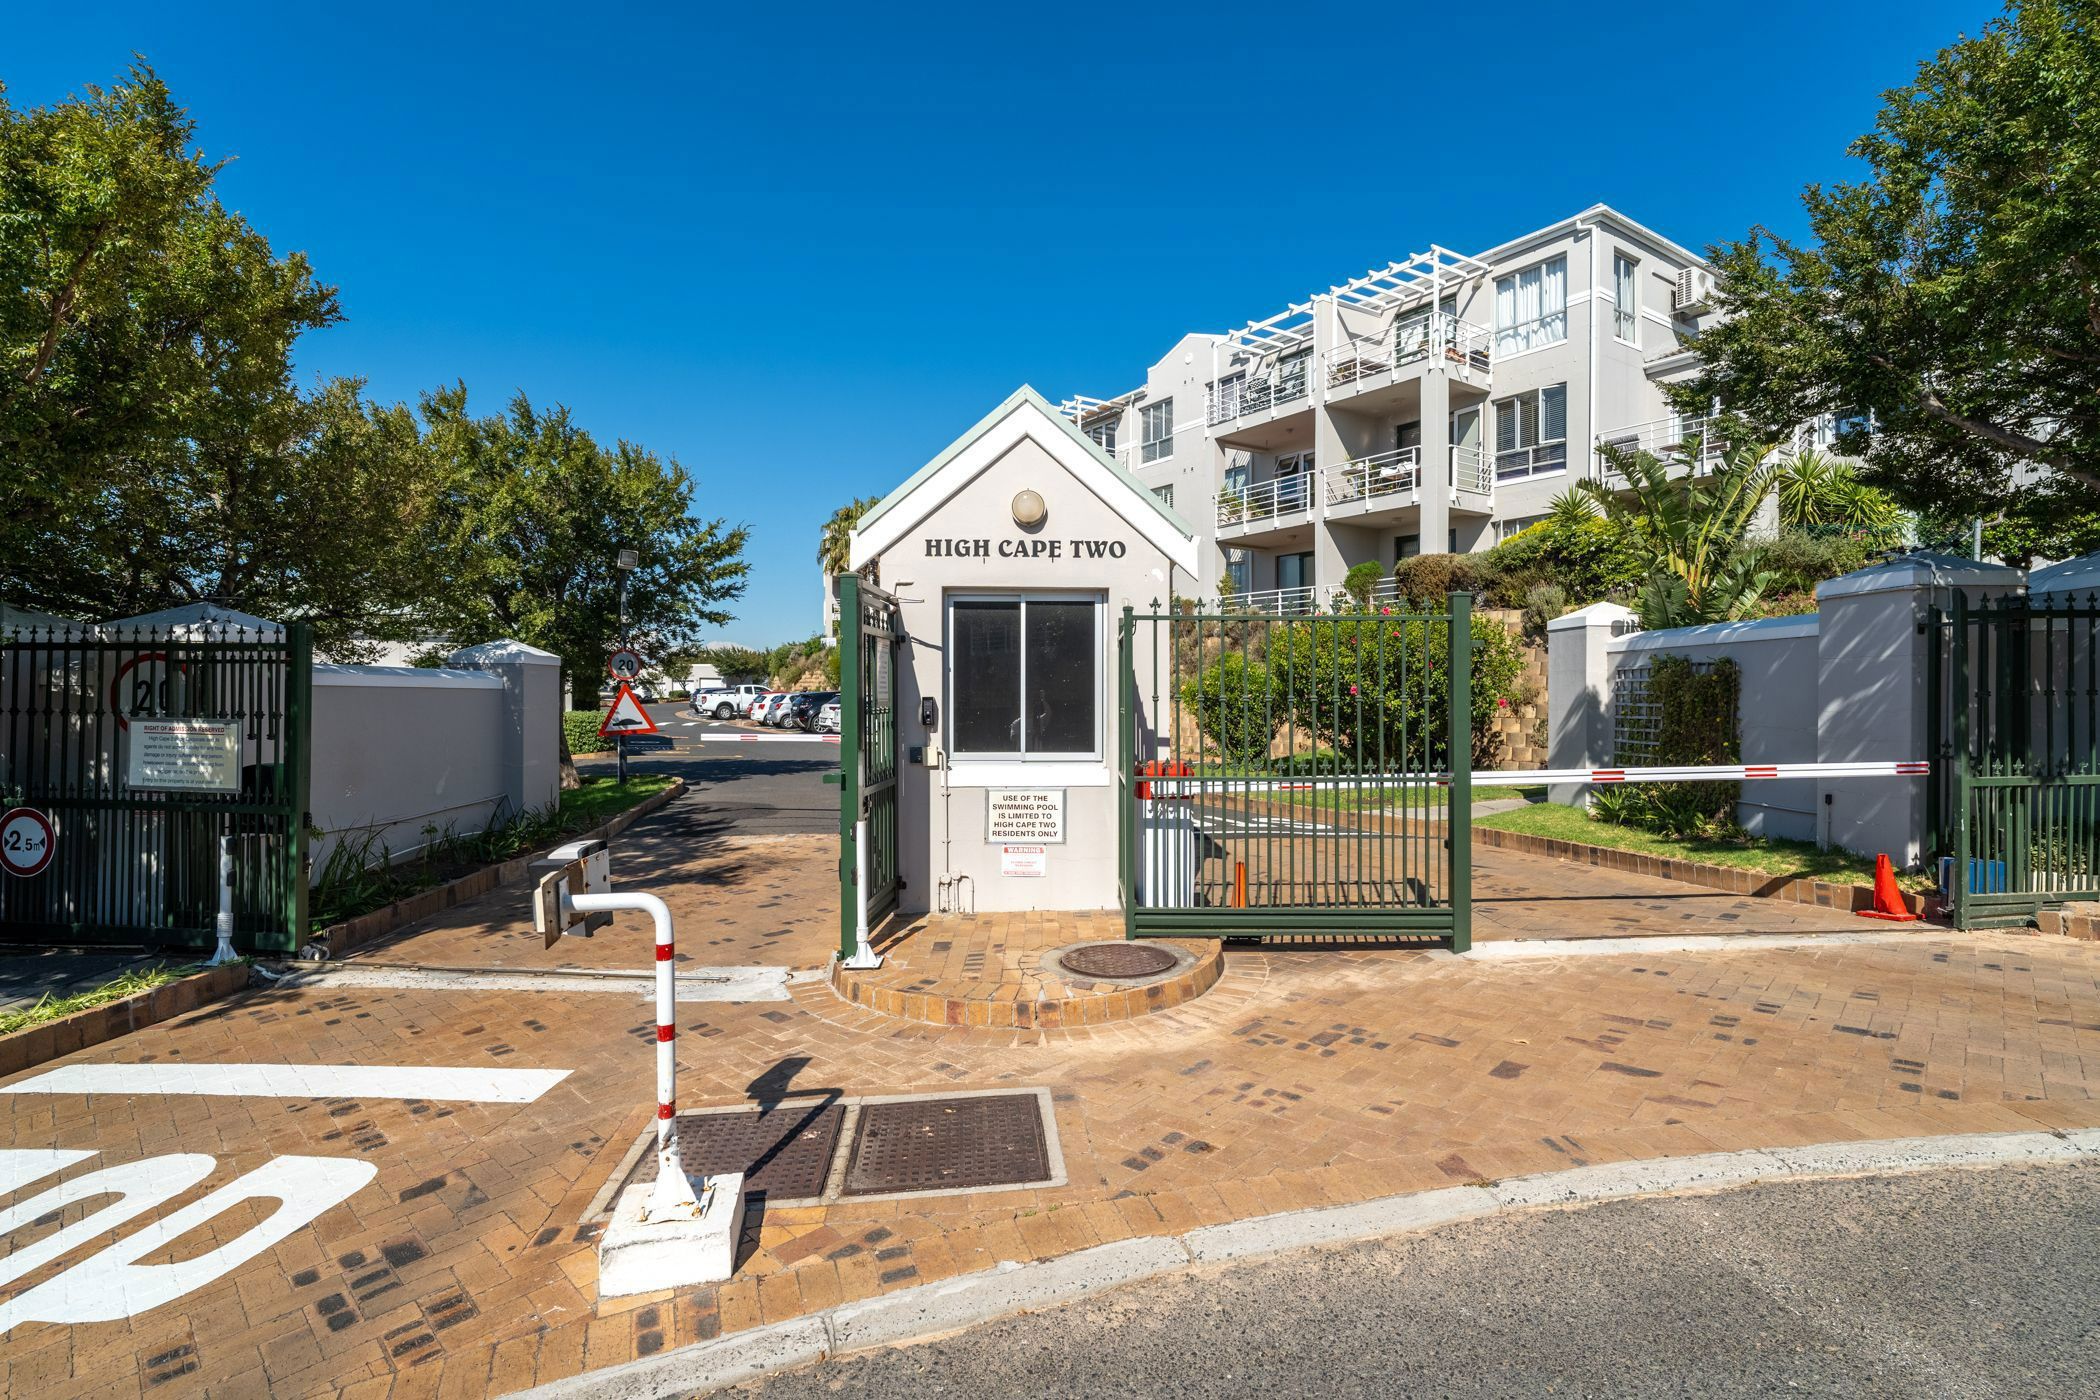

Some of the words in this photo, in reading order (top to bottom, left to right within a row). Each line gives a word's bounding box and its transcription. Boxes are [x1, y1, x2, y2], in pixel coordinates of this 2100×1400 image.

[925, 539, 990, 557] HIGH
[998, 539, 1062, 558] CAPE
[1070, 540, 1127, 558] TWO
[618, 659, 634, 671] 20
[9, 830, 40, 852] 2.5m
